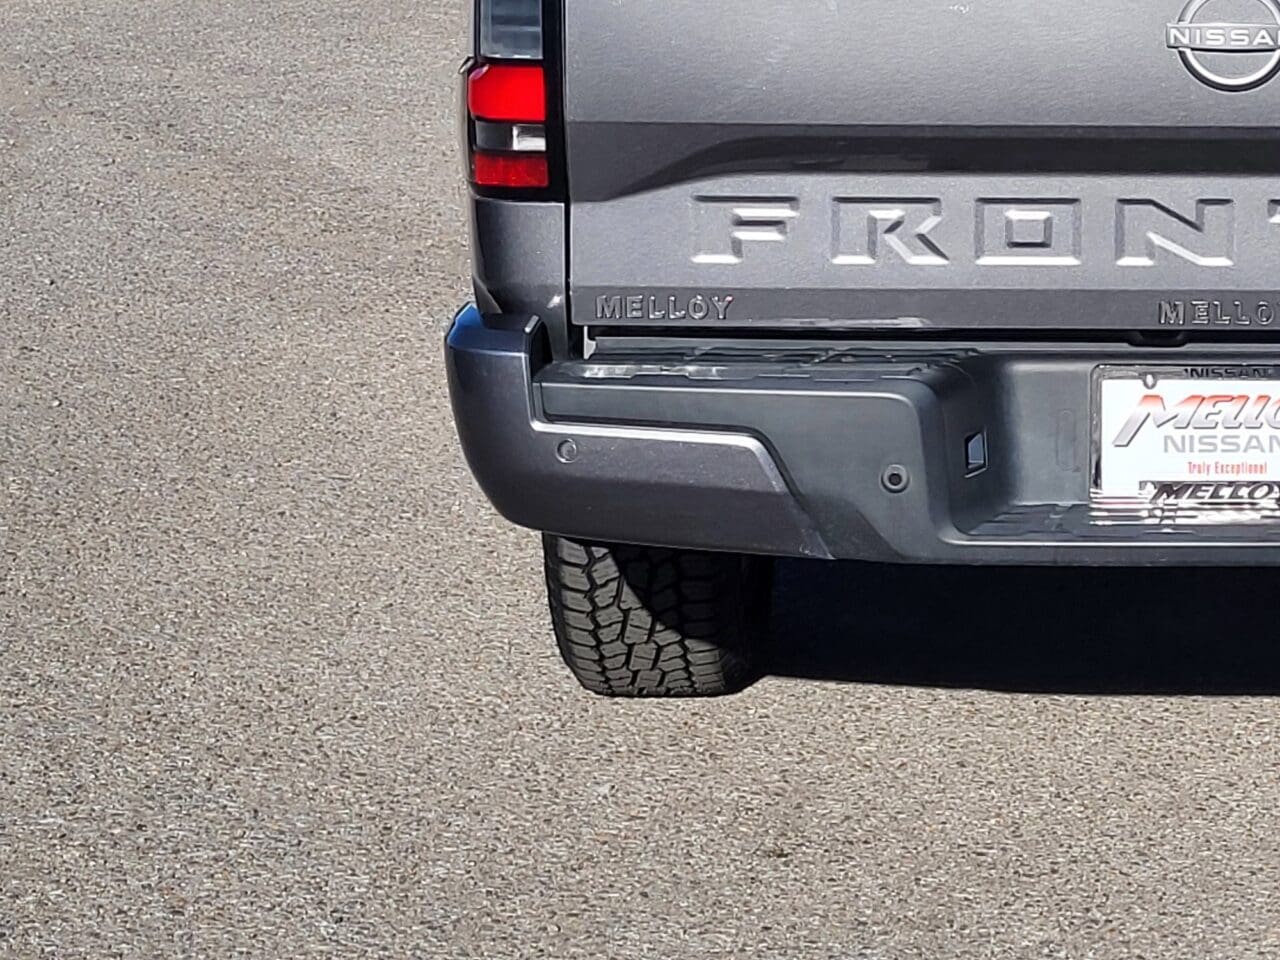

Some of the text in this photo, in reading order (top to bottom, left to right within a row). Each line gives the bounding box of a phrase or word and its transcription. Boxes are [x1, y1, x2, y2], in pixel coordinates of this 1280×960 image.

[595, 294, 733, 320] MELLOY
[1189, 367, 1268, 379] NISSAN
[1187, 461, 1268, 476] Truly Exceptional
